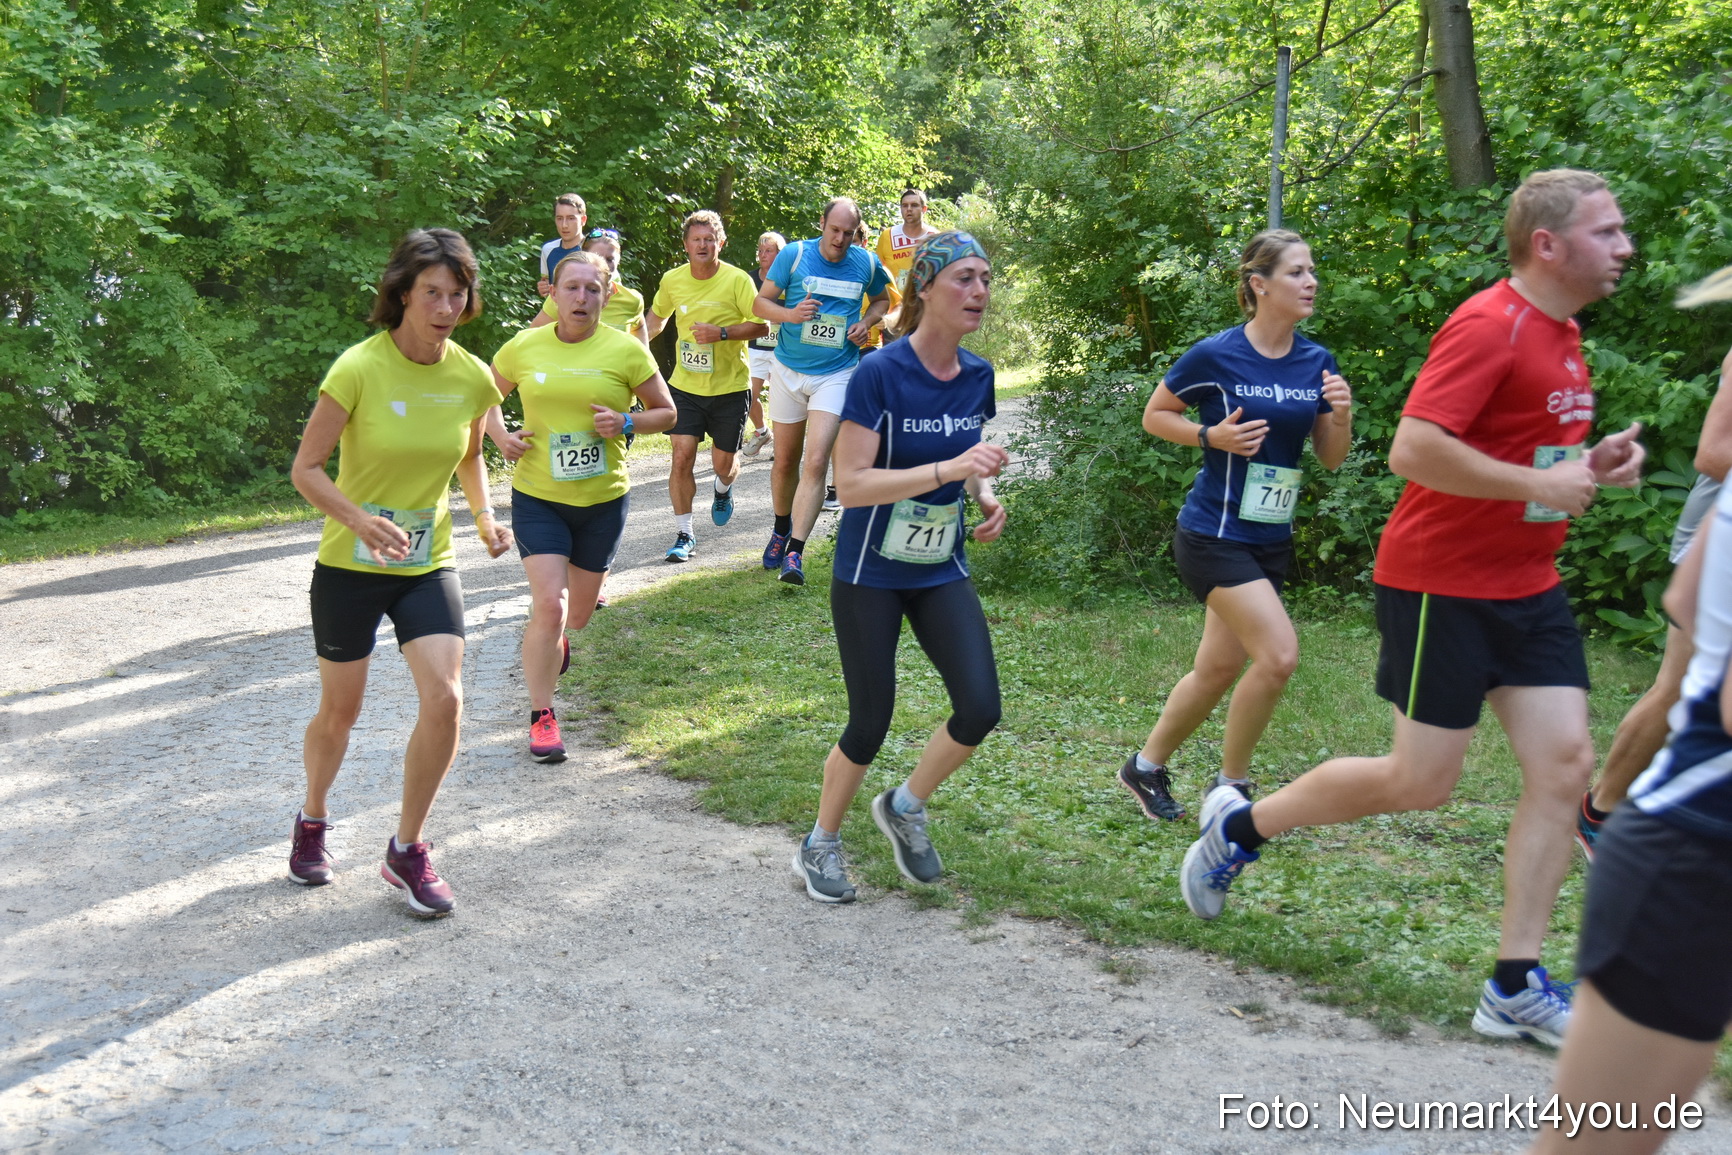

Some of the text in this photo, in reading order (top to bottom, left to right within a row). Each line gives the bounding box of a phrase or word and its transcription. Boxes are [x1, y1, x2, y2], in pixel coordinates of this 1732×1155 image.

[893, 250, 913, 260] MAX
[811, 324, 836, 339] 829
[683, 351, 708, 366] 1245
[1235, 384, 1319, 401] EURO POLES
[903, 418, 943, 433] EURO
[557, 446, 600, 467] 1259
[1261, 486, 1292, 508] 710
[906, 524, 946, 547] 711
